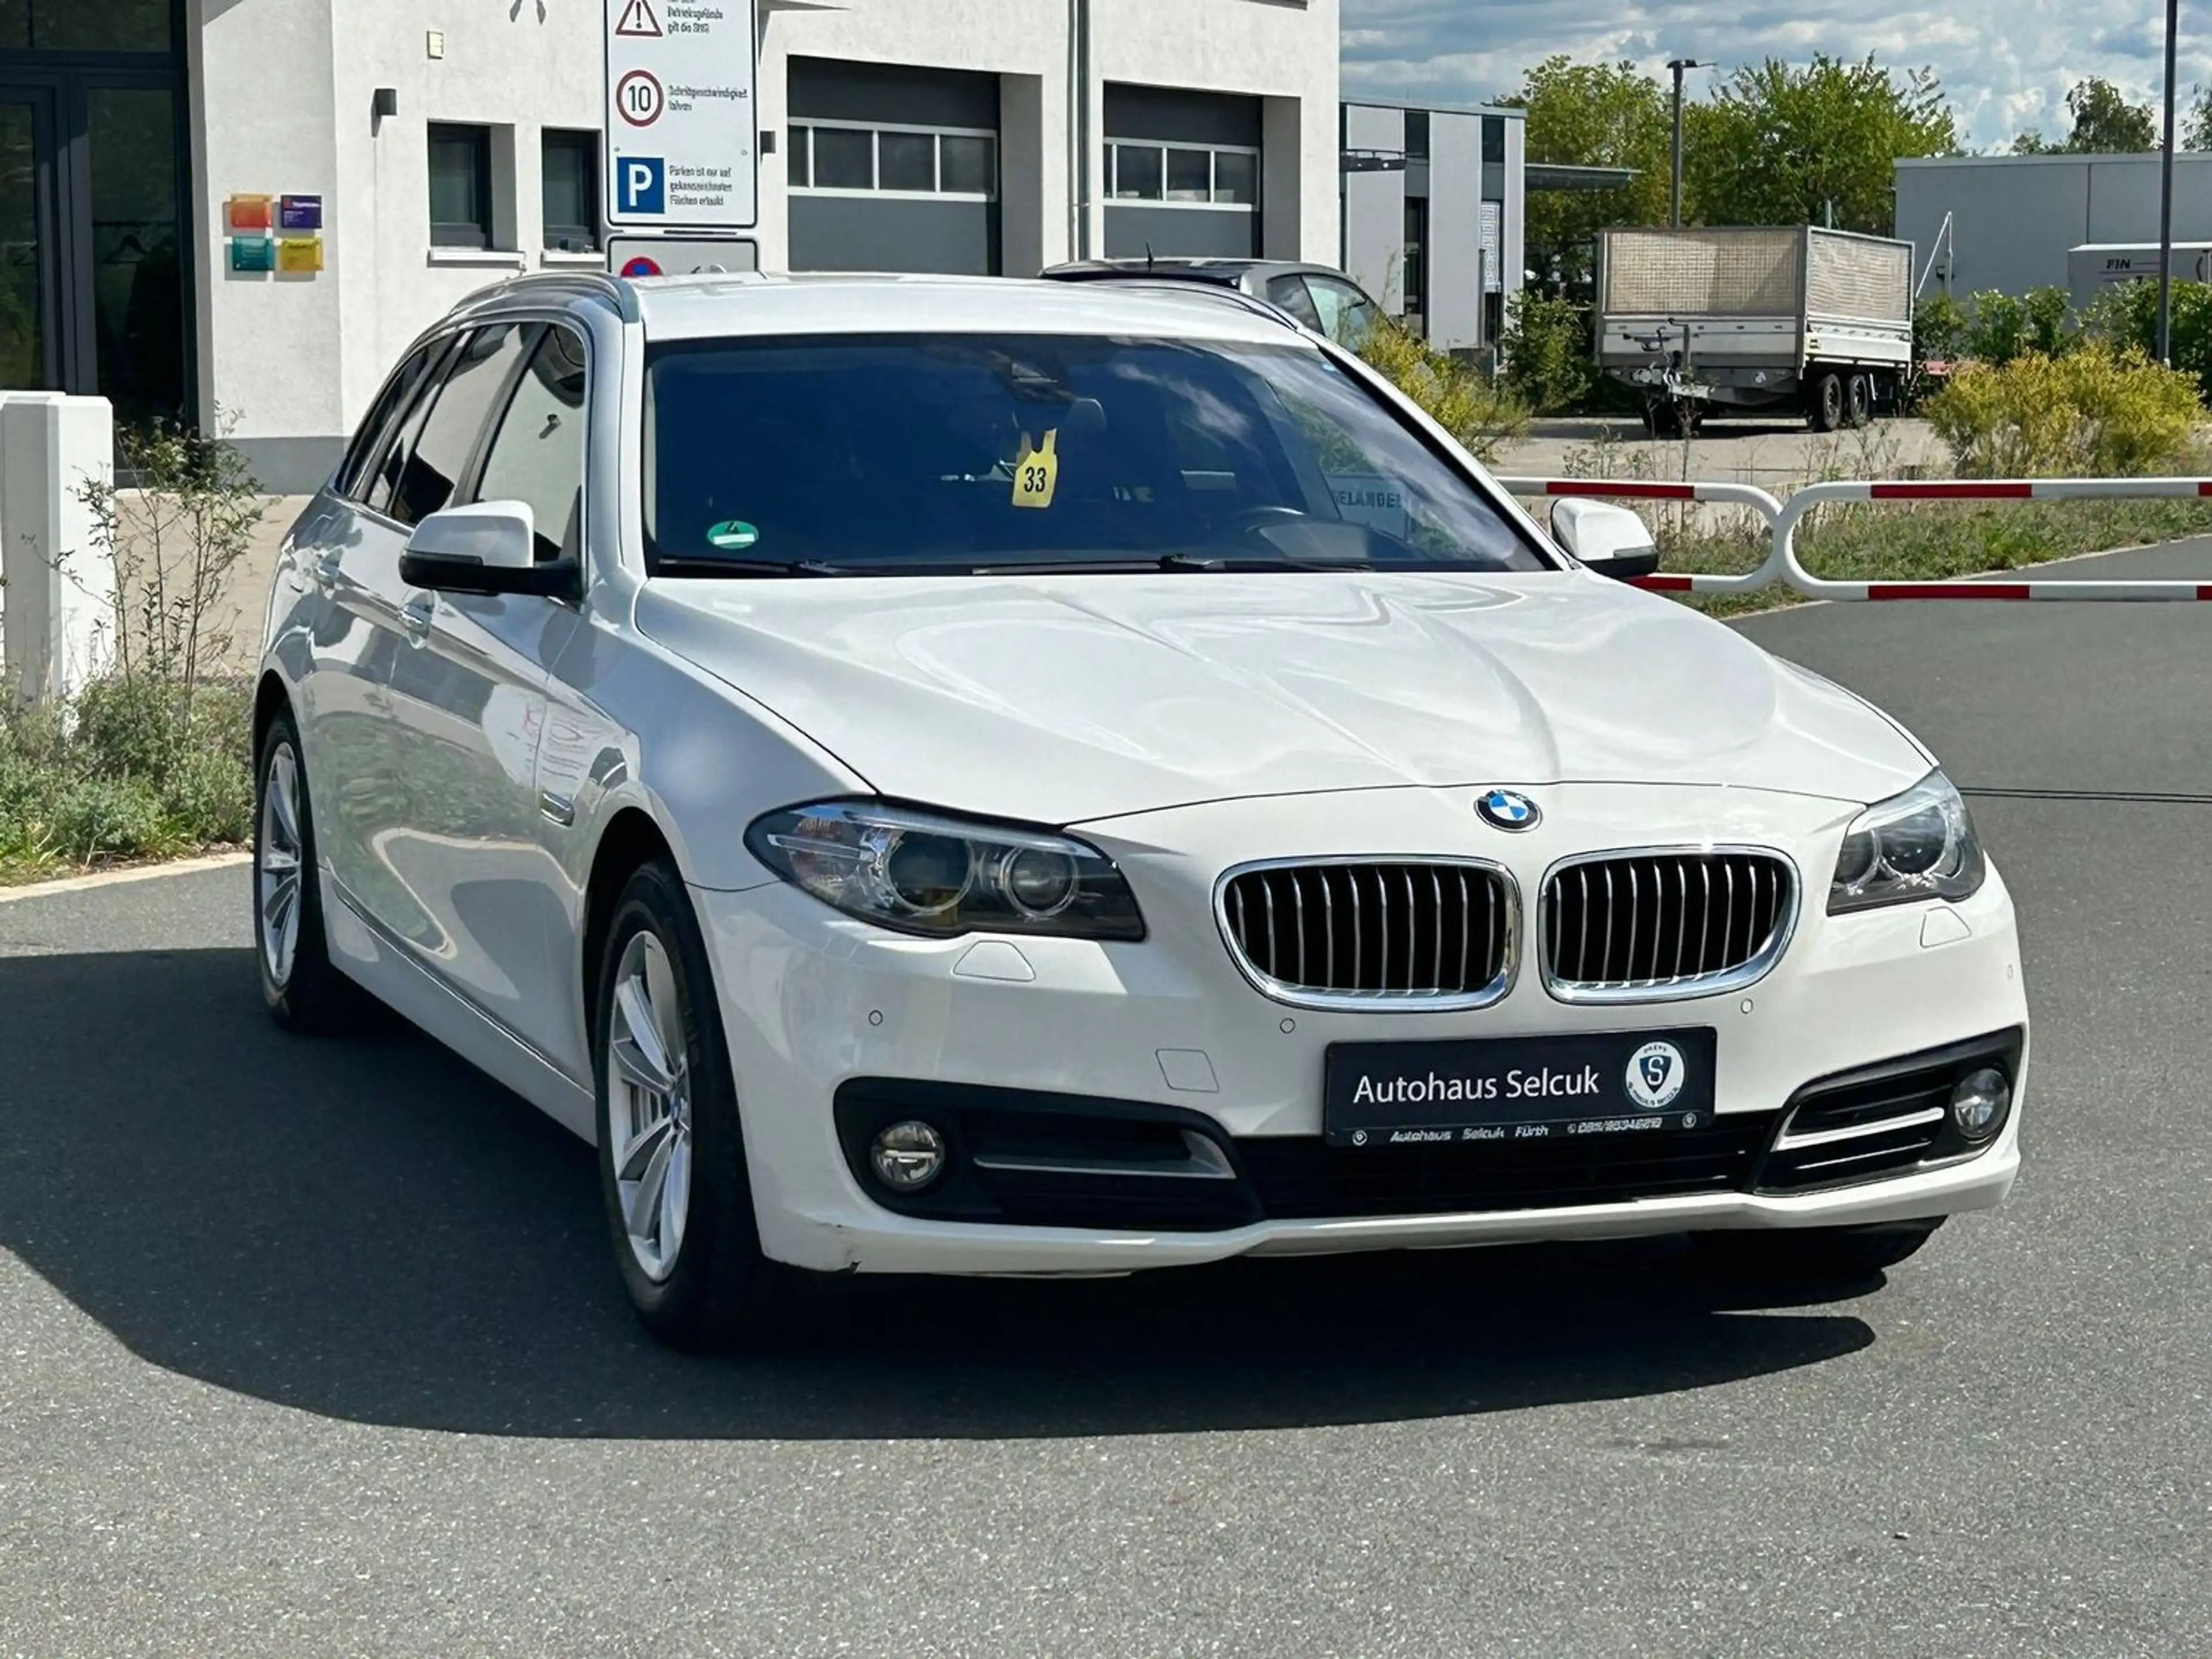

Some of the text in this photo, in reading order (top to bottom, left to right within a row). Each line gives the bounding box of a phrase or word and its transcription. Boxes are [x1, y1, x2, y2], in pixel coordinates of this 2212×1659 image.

[628, 85, 652, 112] 10
[628, 164, 653, 206] P
[1024, 466, 1047, 493] 33
[1353, 1071, 1498, 1104] Autohaus
[1505, 1065, 1600, 1099] Selcuk
[1647, 1055, 1664, 1086] S
